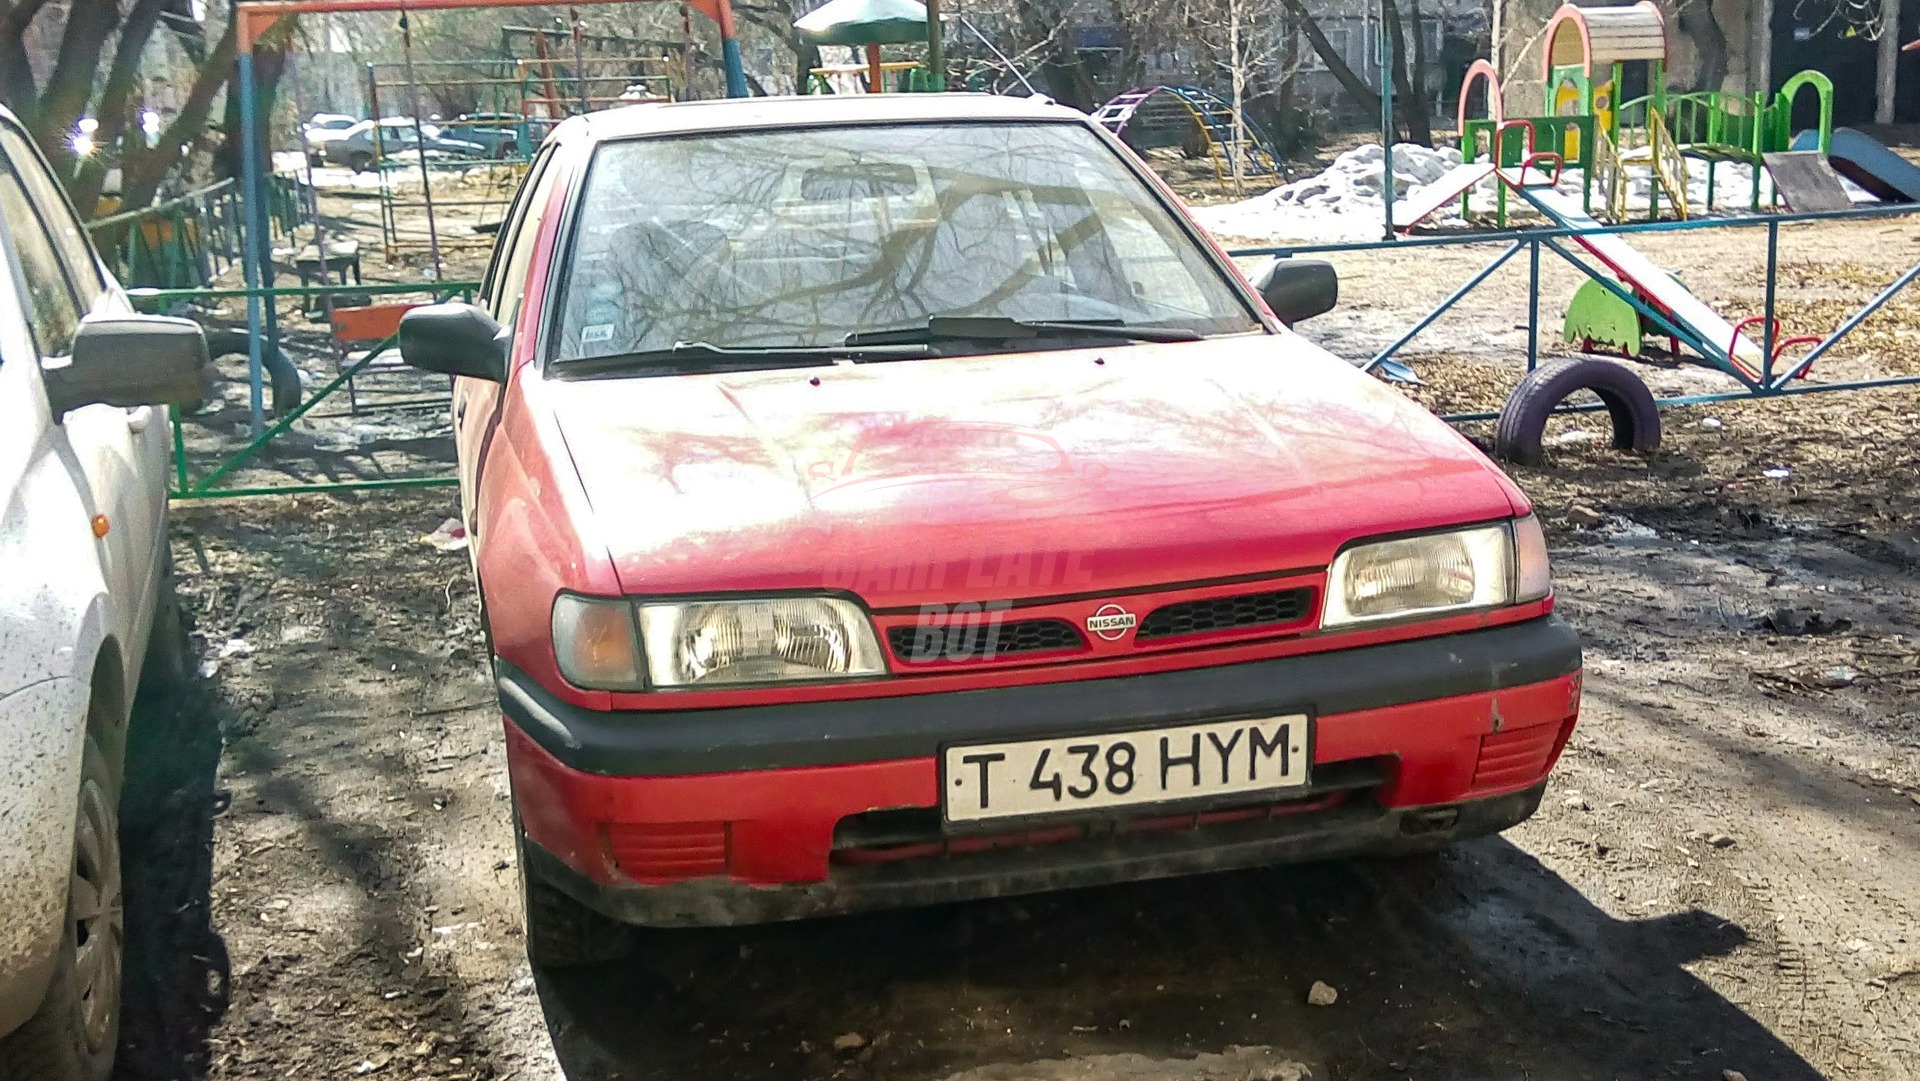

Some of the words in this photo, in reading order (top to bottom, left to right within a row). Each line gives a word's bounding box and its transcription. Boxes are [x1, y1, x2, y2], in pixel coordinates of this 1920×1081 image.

[1089, 616, 1134, 629] NISSAN
[962, 752, 1006, 809] T
[1029, 741, 1136, 801] 438
[1159, 724, 1290, 790] HYM
